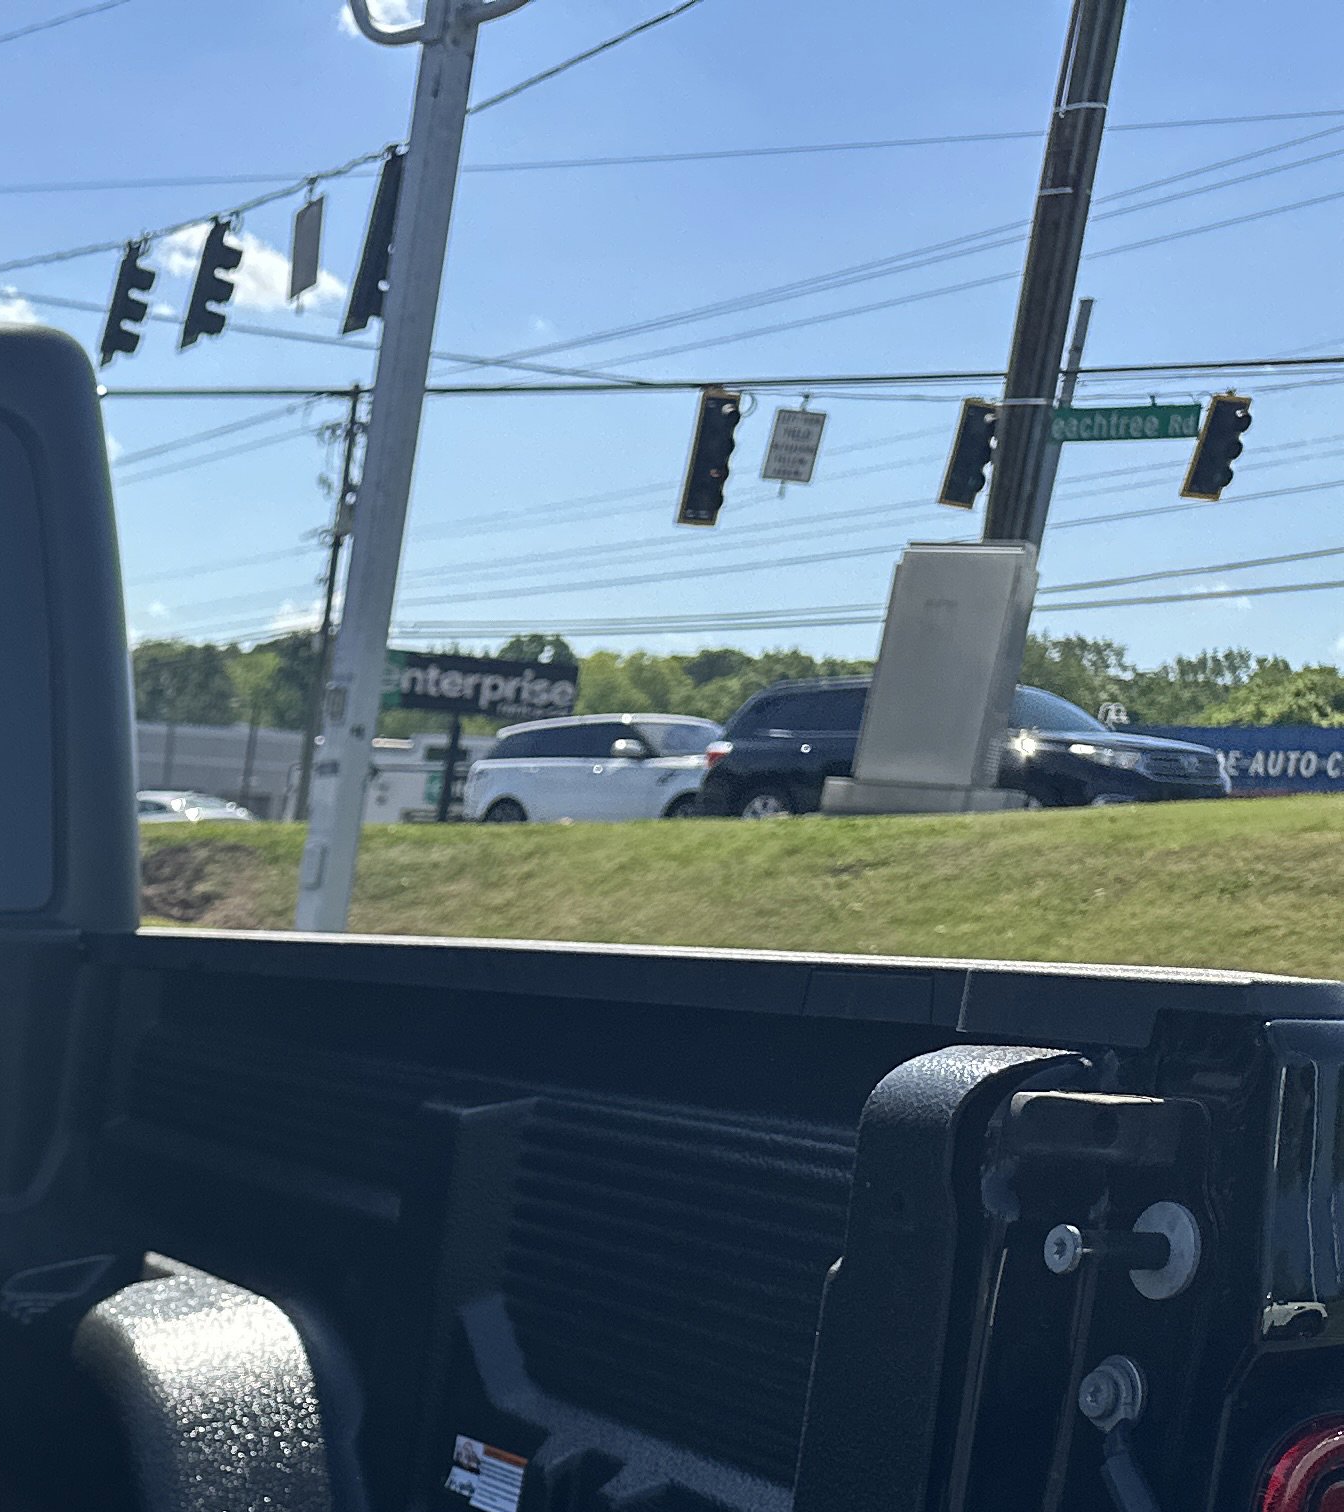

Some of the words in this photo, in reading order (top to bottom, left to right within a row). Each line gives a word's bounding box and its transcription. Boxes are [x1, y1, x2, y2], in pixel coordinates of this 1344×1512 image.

[1051, 411, 1159, 441] eachtree
[1168, 413, 1197, 437] Rd
[1248, 750, 1319, 779] AUTO
